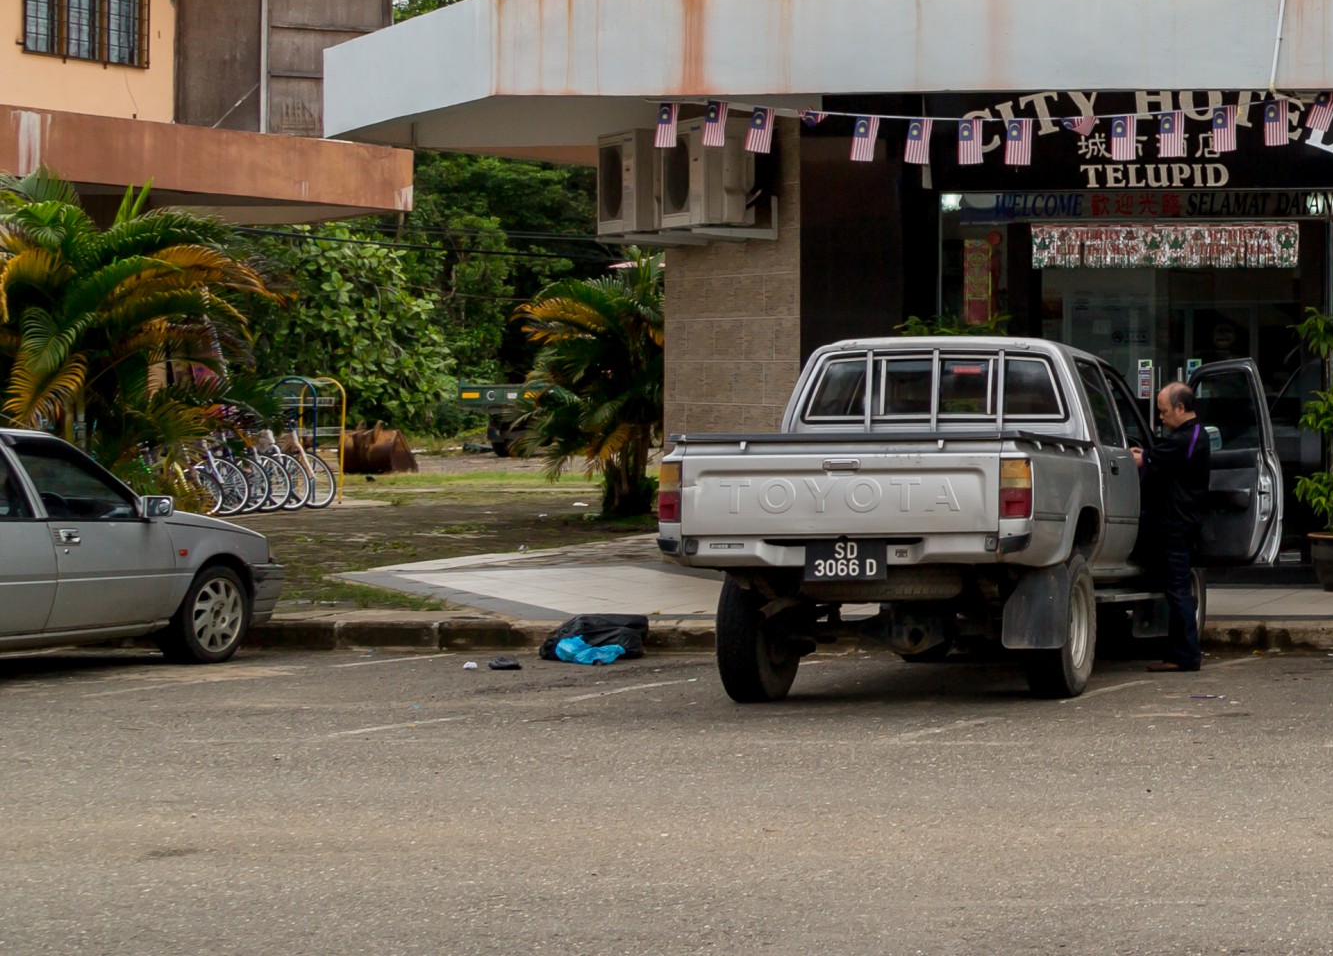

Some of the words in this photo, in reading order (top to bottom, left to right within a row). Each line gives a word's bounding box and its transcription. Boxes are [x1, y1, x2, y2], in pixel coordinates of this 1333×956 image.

[1077, 132, 1221, 159] 城店
[1080, 163, 1230, 188] TELUPID
[995, 194, 1084, 217] WELCOME
[1186, 193, 1272, 216] SELAMAT
[719, 476, 961, 514] TOYOTA
[834, 542, 858, 559] SD
[814, 560, 859, 577] 3066
[866, 560, 877, 576] D
